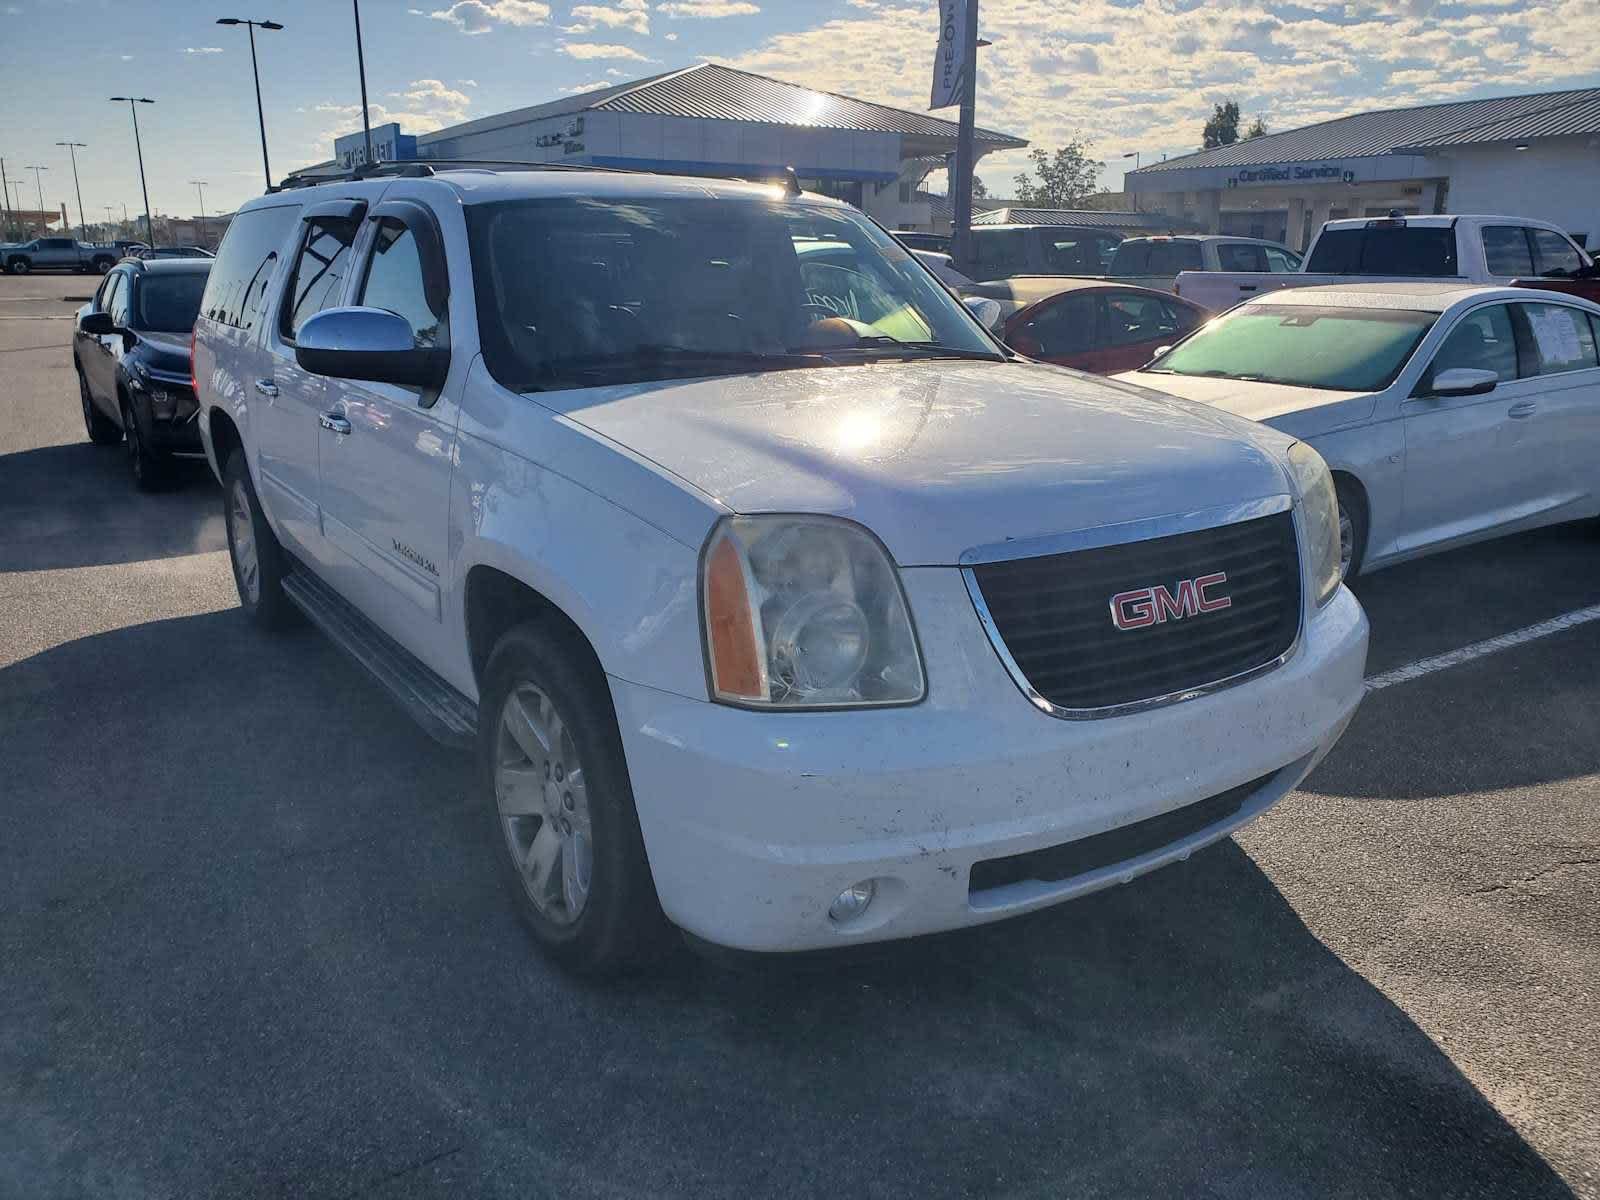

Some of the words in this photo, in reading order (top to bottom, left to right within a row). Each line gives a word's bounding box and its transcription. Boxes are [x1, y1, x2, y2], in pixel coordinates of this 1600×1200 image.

[1239, 167, 1290, 182] Certified
[1294, 164, 1341, 180] Service
[1109, 571, 1232, 631] GMC
